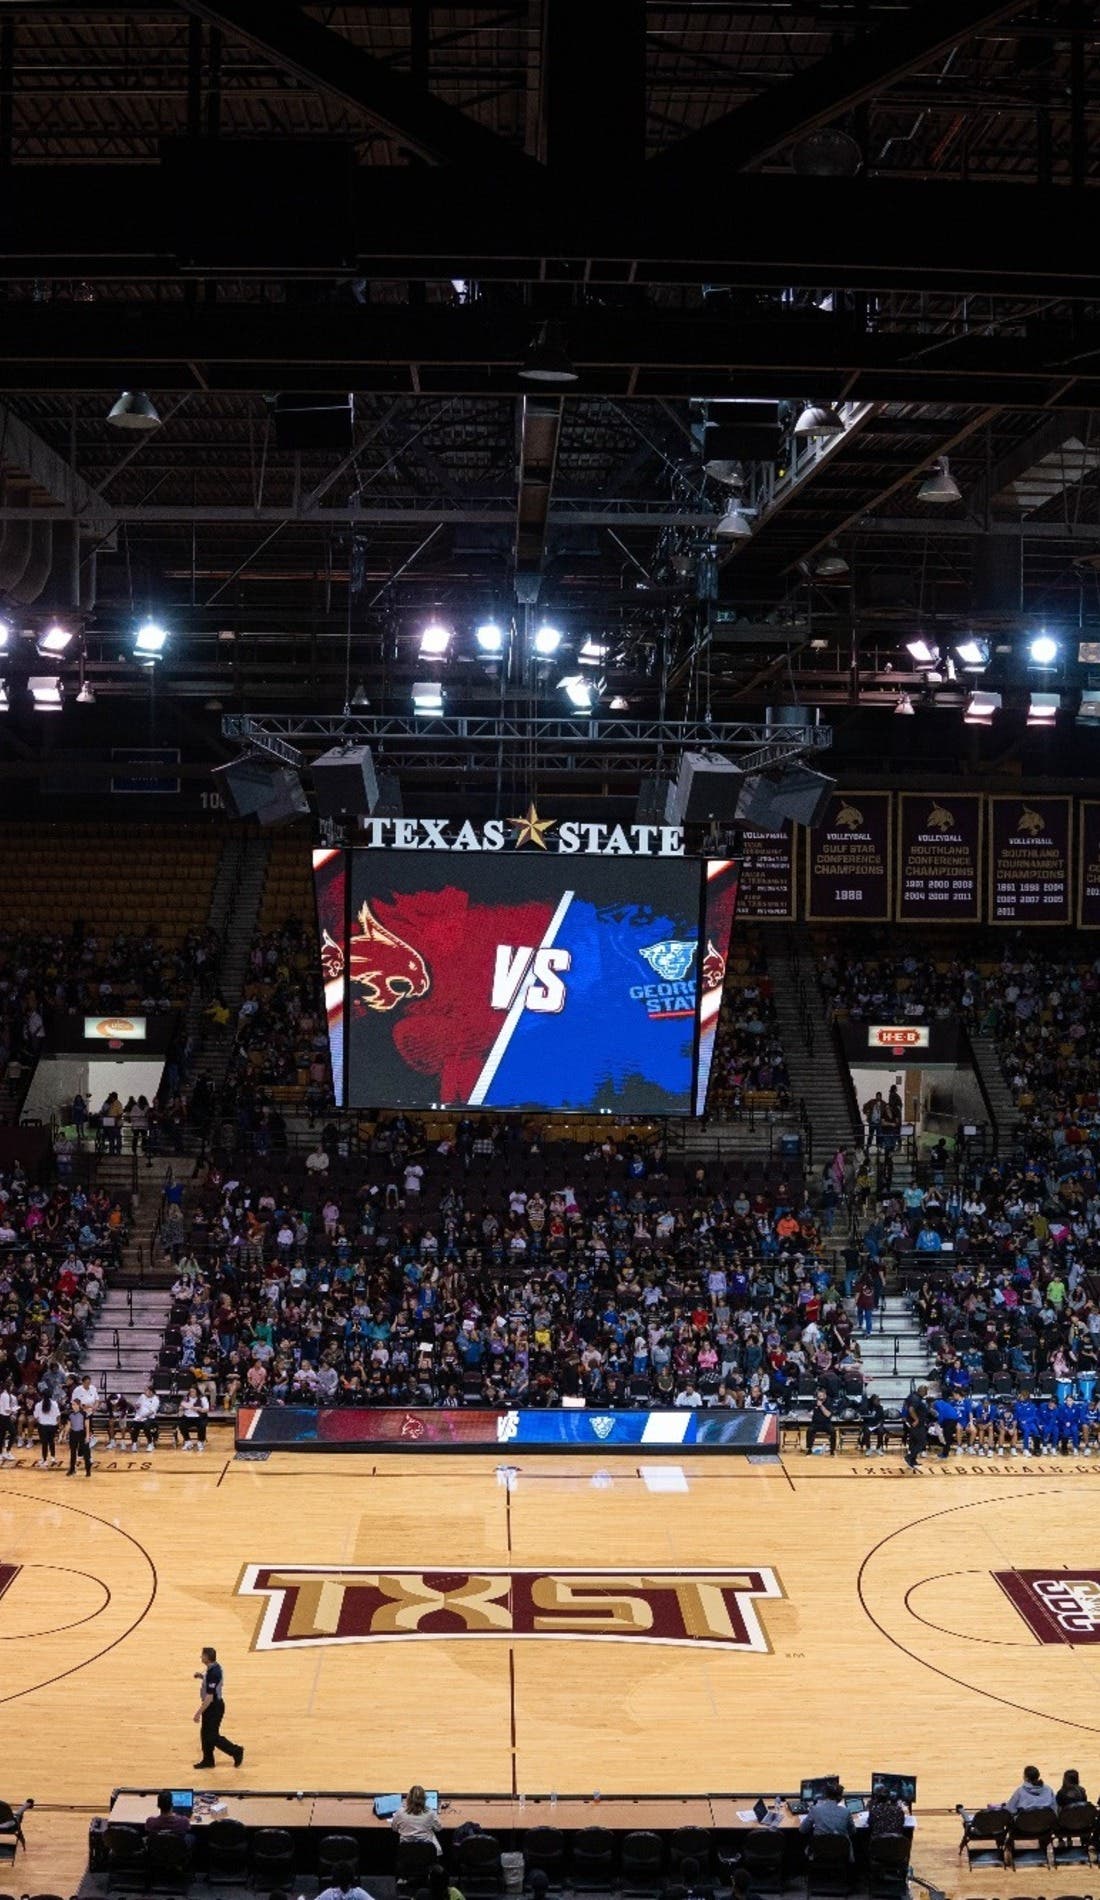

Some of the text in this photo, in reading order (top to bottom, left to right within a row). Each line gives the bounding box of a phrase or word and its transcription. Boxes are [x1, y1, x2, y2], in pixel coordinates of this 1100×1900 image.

[364, 817, 686, 856] TEXAS STATE
[826, 833, 872, 841] VOLLEYBALL
[918, 834, 962, 842] VOLLEYBALL
[1008, 837, 1053, 845] VOLLEYBALL
[823, 844, 876, 854] GULF STAR
[911, 846, 970, 855] SOUTHLAND
[1001, 848, 1060, 858] SOUTHLAND
[816, 854, 881, 864] CONFERENCE
[908, 856, 971, 865] CONFERENCE
[997, 859, 1064, 869] TOURNAMENT
[814, 865, 884, 875] CHAMPIONS
[905, 866, 974, 876] CHAMPIONS
[997, 870, 1065, 879] CHAMPIONS
[490, 944, 571, 1012] VS
[497, 1414, 520, 1439] VS
[266, 1573, 755, 1639] TXST
